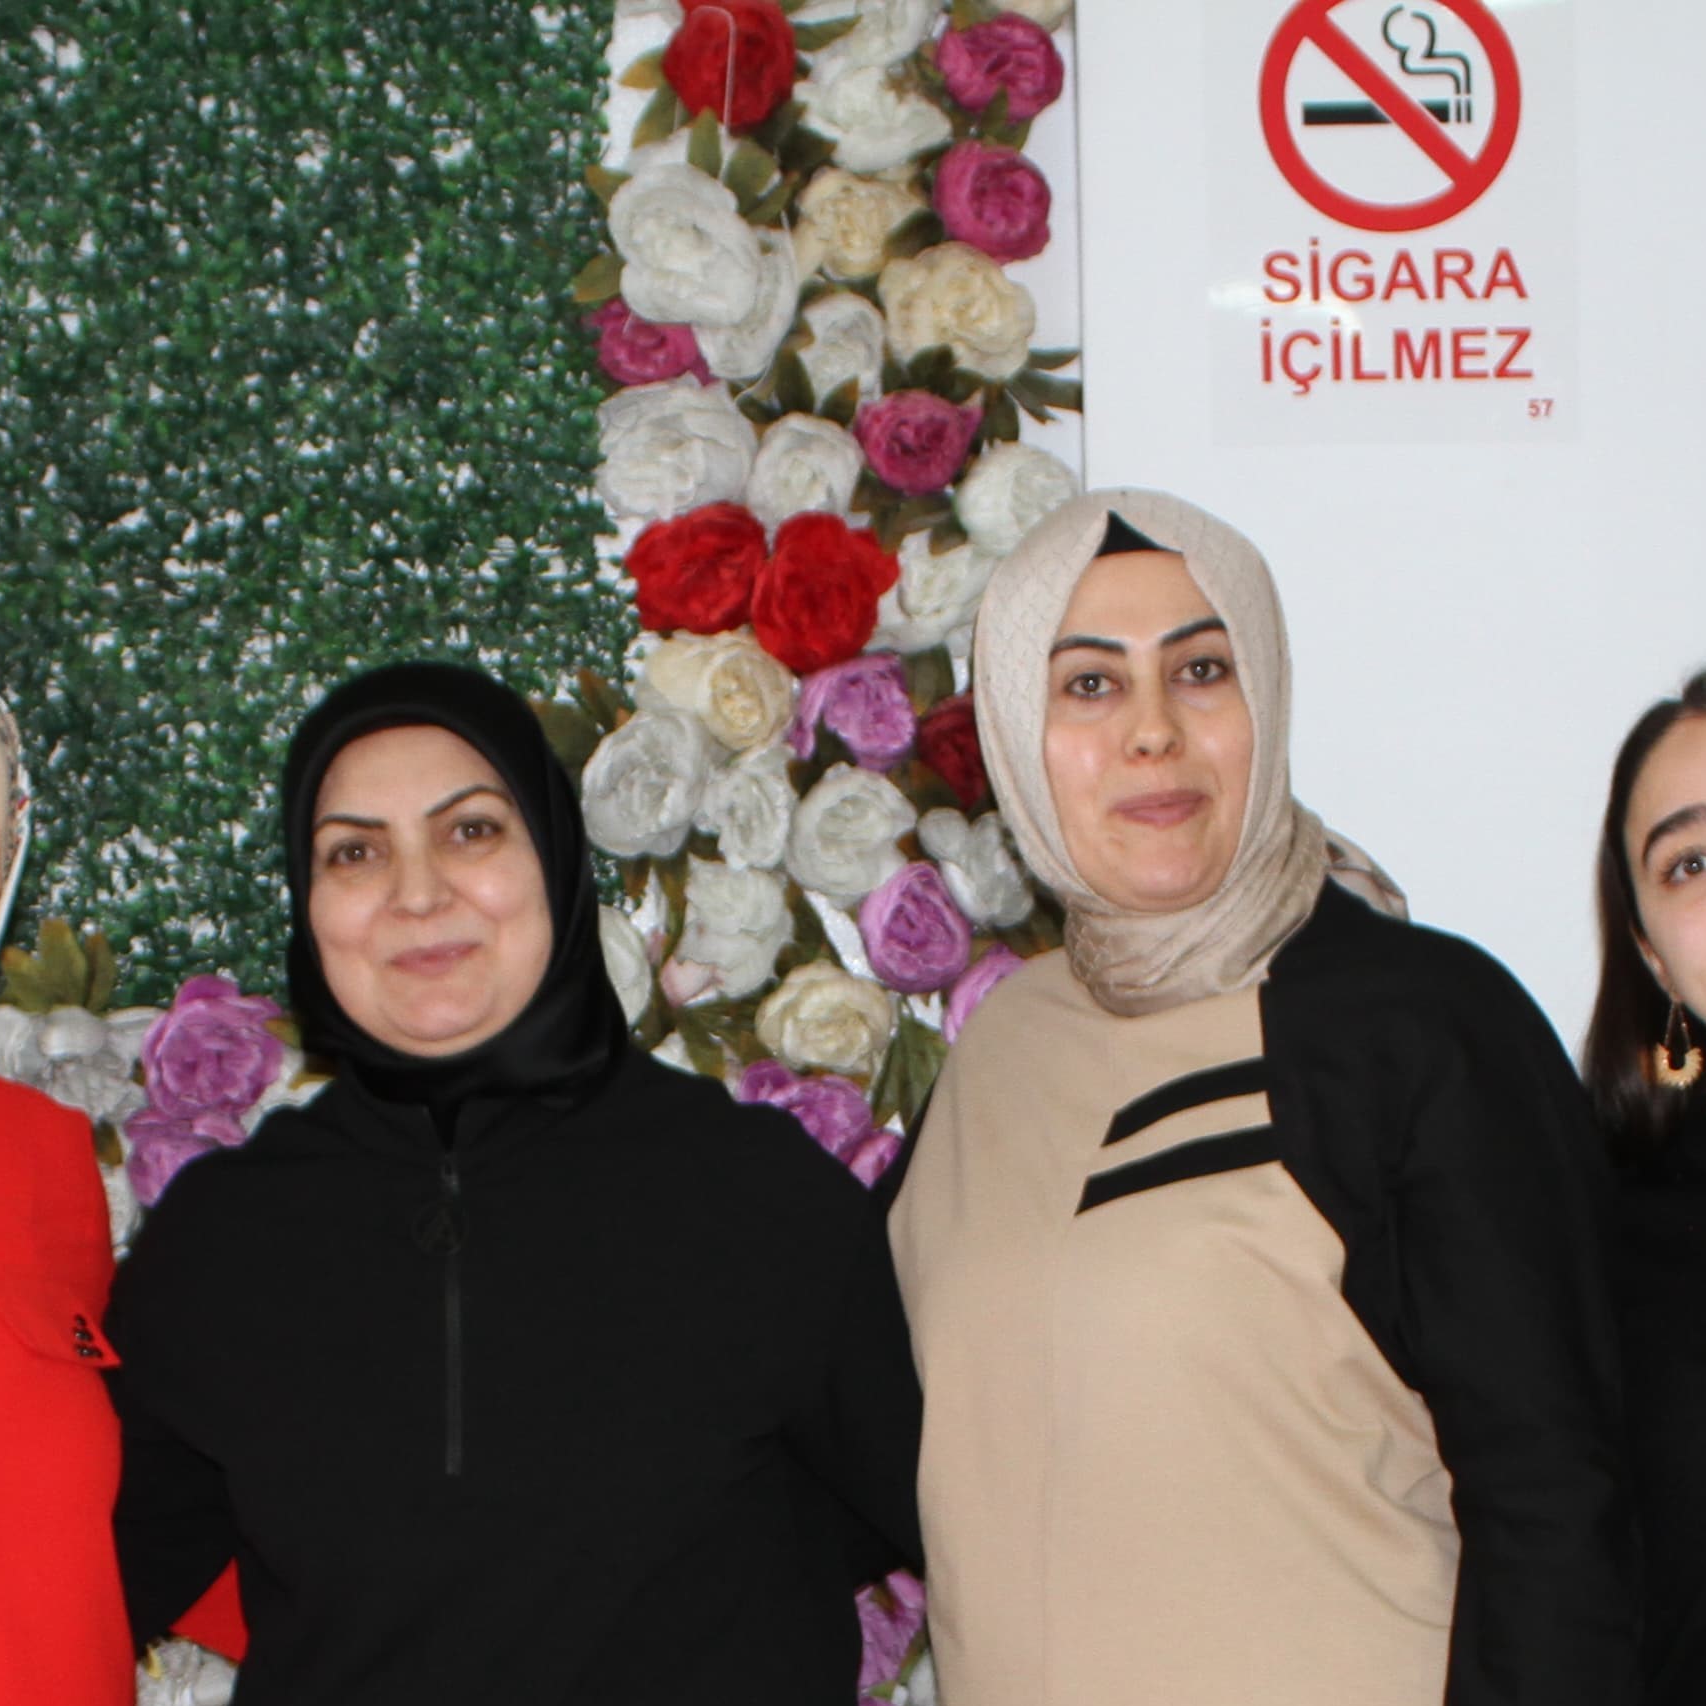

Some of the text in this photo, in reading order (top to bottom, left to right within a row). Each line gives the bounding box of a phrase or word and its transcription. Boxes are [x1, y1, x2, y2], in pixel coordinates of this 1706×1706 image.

[1262, 237, 1529, 303] SİGARA
[1260, 317, 1534, 396] İÇİLMEZ
[1528, 398, 1555, 418] 57
